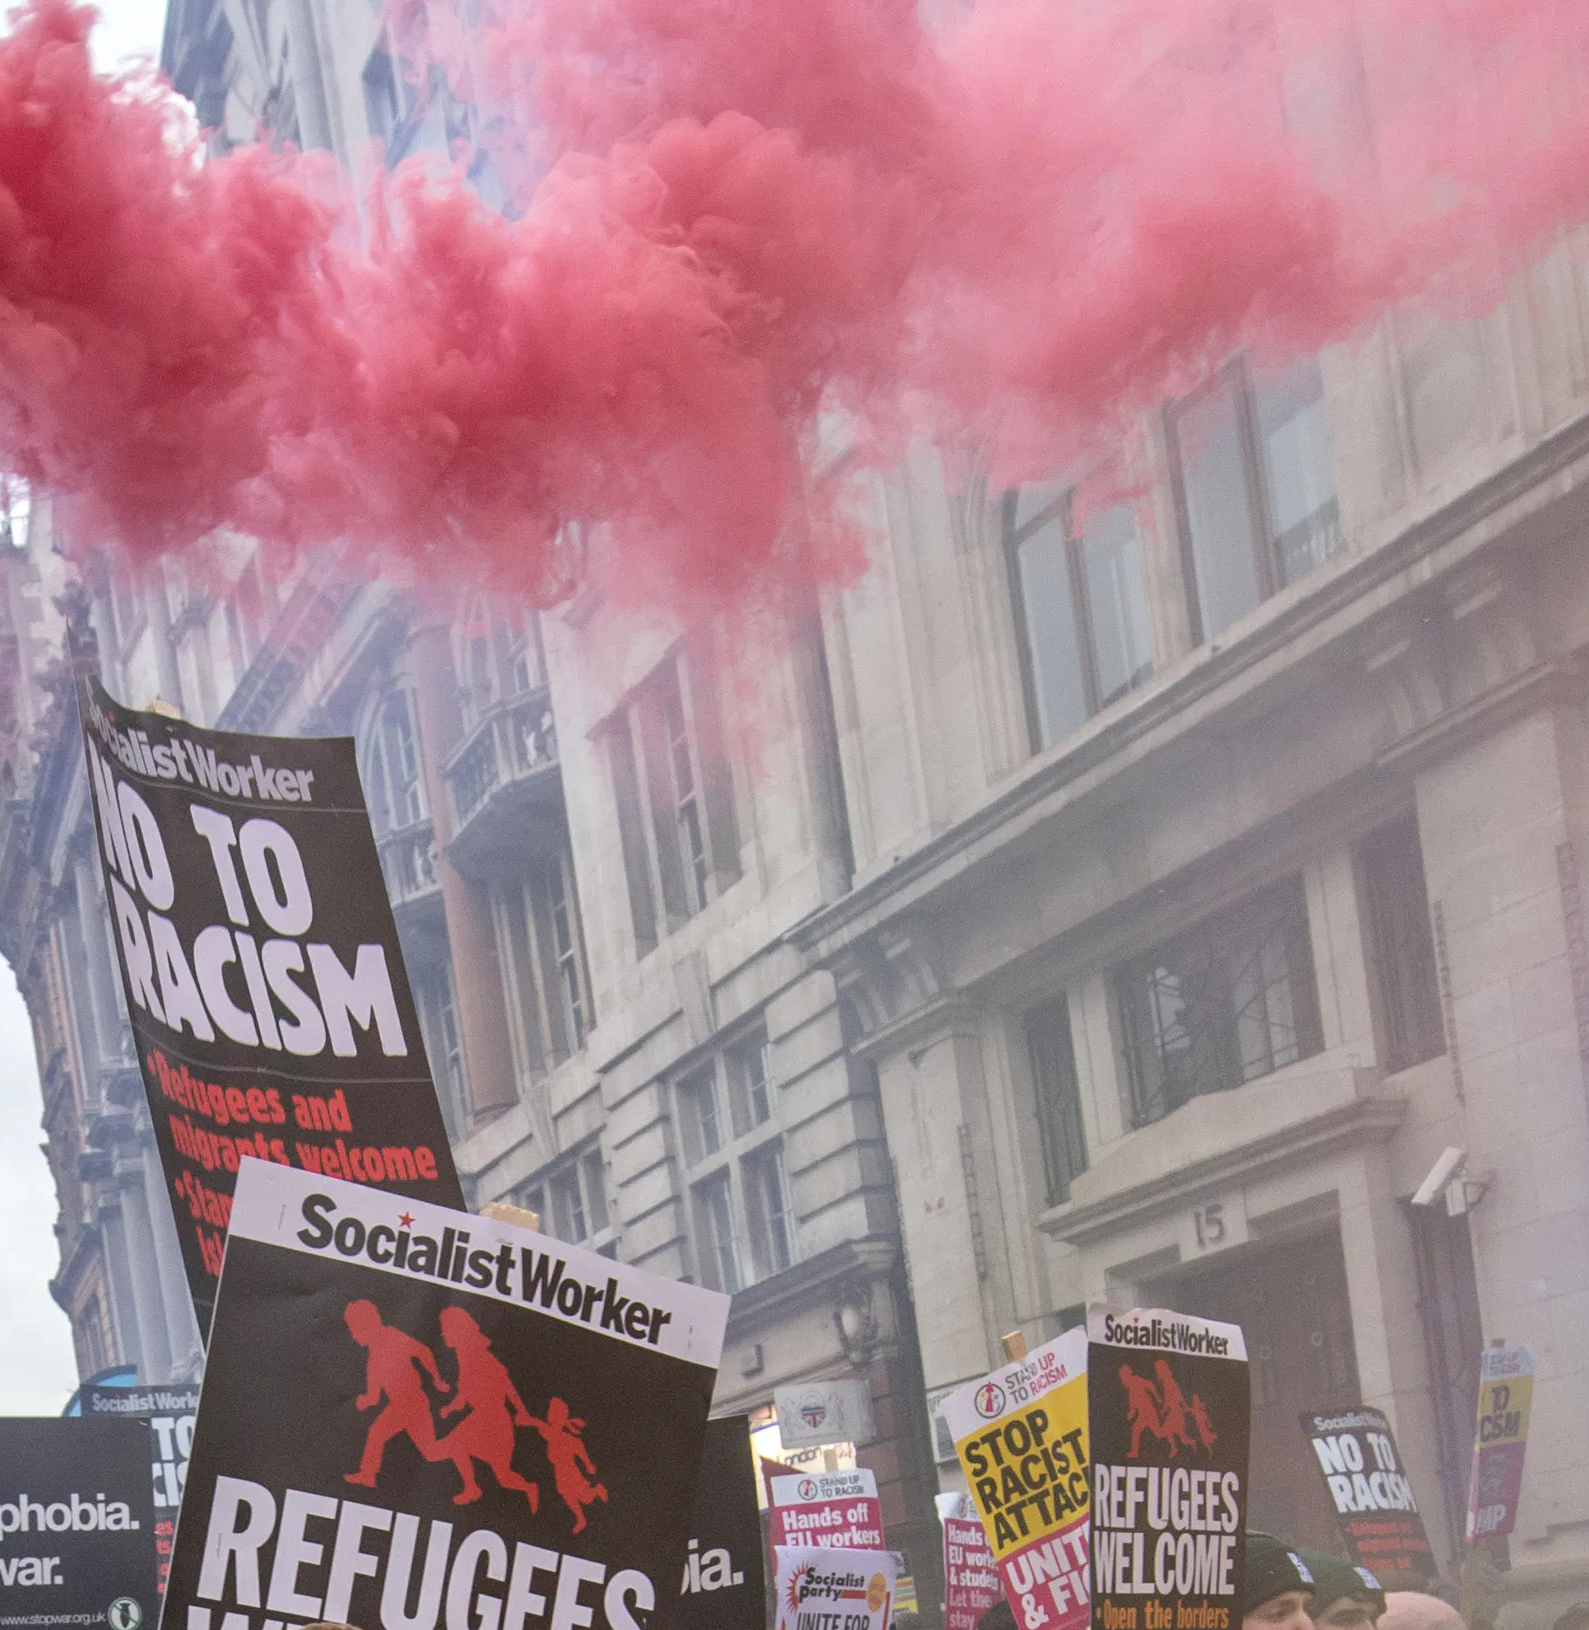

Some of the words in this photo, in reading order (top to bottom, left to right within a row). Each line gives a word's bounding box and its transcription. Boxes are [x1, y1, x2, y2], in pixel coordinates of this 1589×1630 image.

[87, 729, 175, 912] NO
[189, 804, 314, 936] TO
[111, 877, 409, 1057] RACISM
[155, 1054, 286, 1126] Refugees
[293, 1089, 353, 1133] and
[296, 1136, 439, 1182] welcome
[1037, 1352, 1056, 1370] UP
[1009, 1385, 1029, 1405] TO
[1029, 1364, 1068, 1395] RACISM
[964, 1408, 1050, 1478] STOP
[1312, 1434, 1363, 1475] NO
[1366, 1432, 1396, 1471] TO
[822, 1488, 833, 1497] TO
[848, 1476, 860, 1485] UP
[975, 1427, 1086, 1515] RACIST
[1327, 1471, 1418, 1514] RACISM
[782, 1507, 842, 1530] Hands
[846, 1503, 869, 1523] off
[993, 1465, 1090, 1551] ATTAC
[1095, 1463, 1238, 1533] REFUGEES
[785, 1533, 812, 1548] EU
[816, 1526, 880, 1548] workers
[948, 1524, 982, 1546] Hands
[949, 1545, 963, 1565] EU
[1005, 1519, 1090, 1594] UNIT
[805, 1567, 865, 1587] Socialist
[1094, 1531, 1236, 1595] WELCOME
[0, 1612, 106, 1626] www.stopwar.org.uk
[1143, 1601, 1172, 1629] the
[1177, 1600, 1229, 1629] borders
